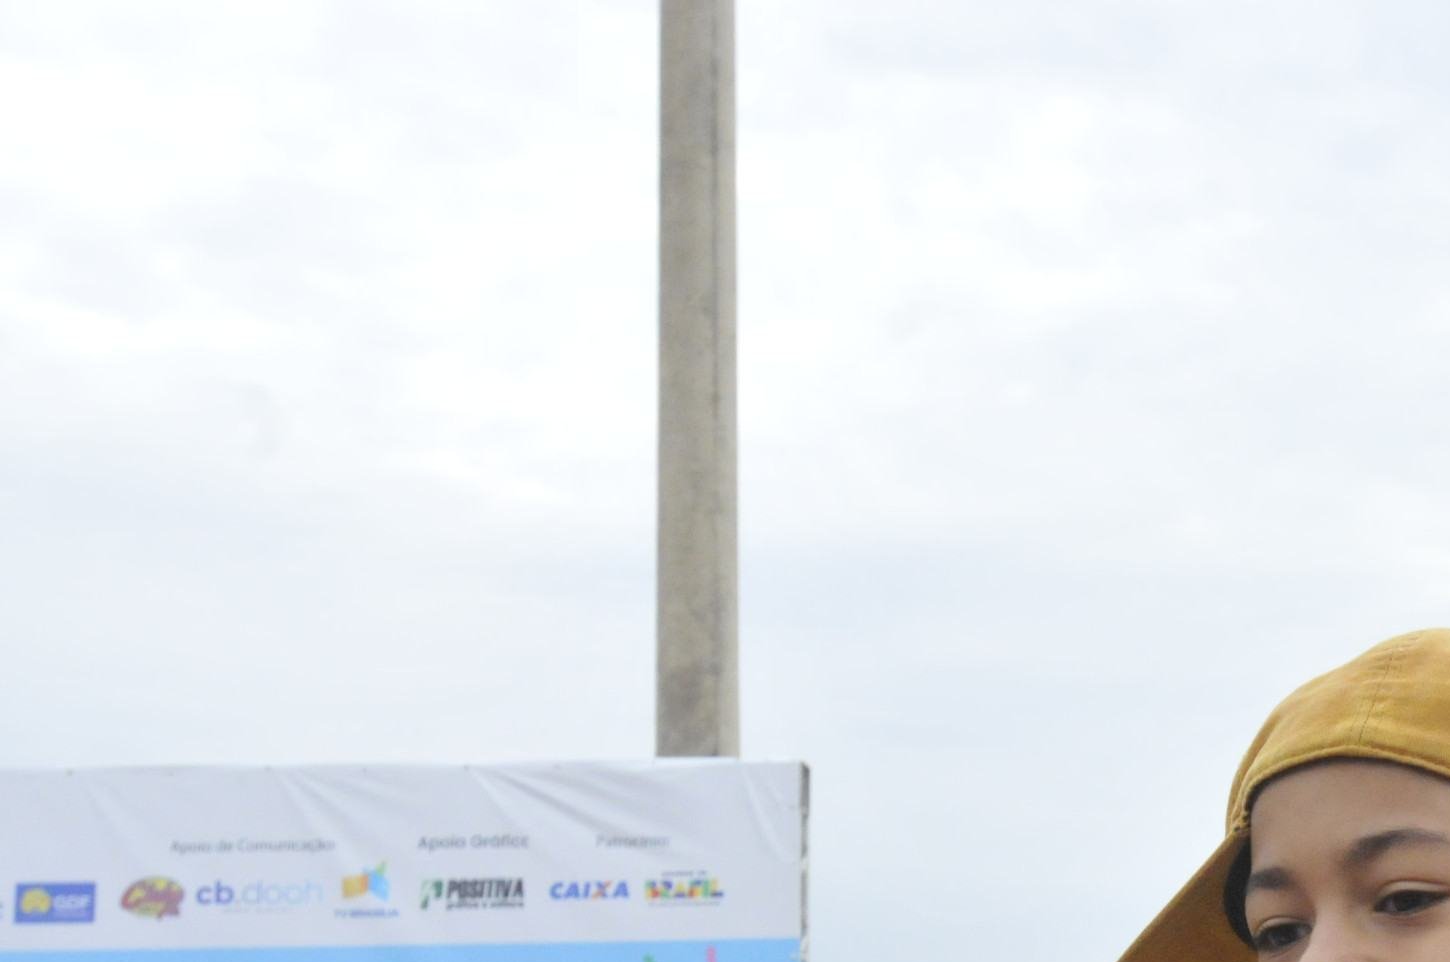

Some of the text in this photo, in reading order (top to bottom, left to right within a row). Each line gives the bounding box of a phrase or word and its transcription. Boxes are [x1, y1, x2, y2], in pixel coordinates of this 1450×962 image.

[418, 837, 466, 852] Apoio
[446, 878, 524, 899] POSITIVA
[549, 880, 630, 899] CAIXA
